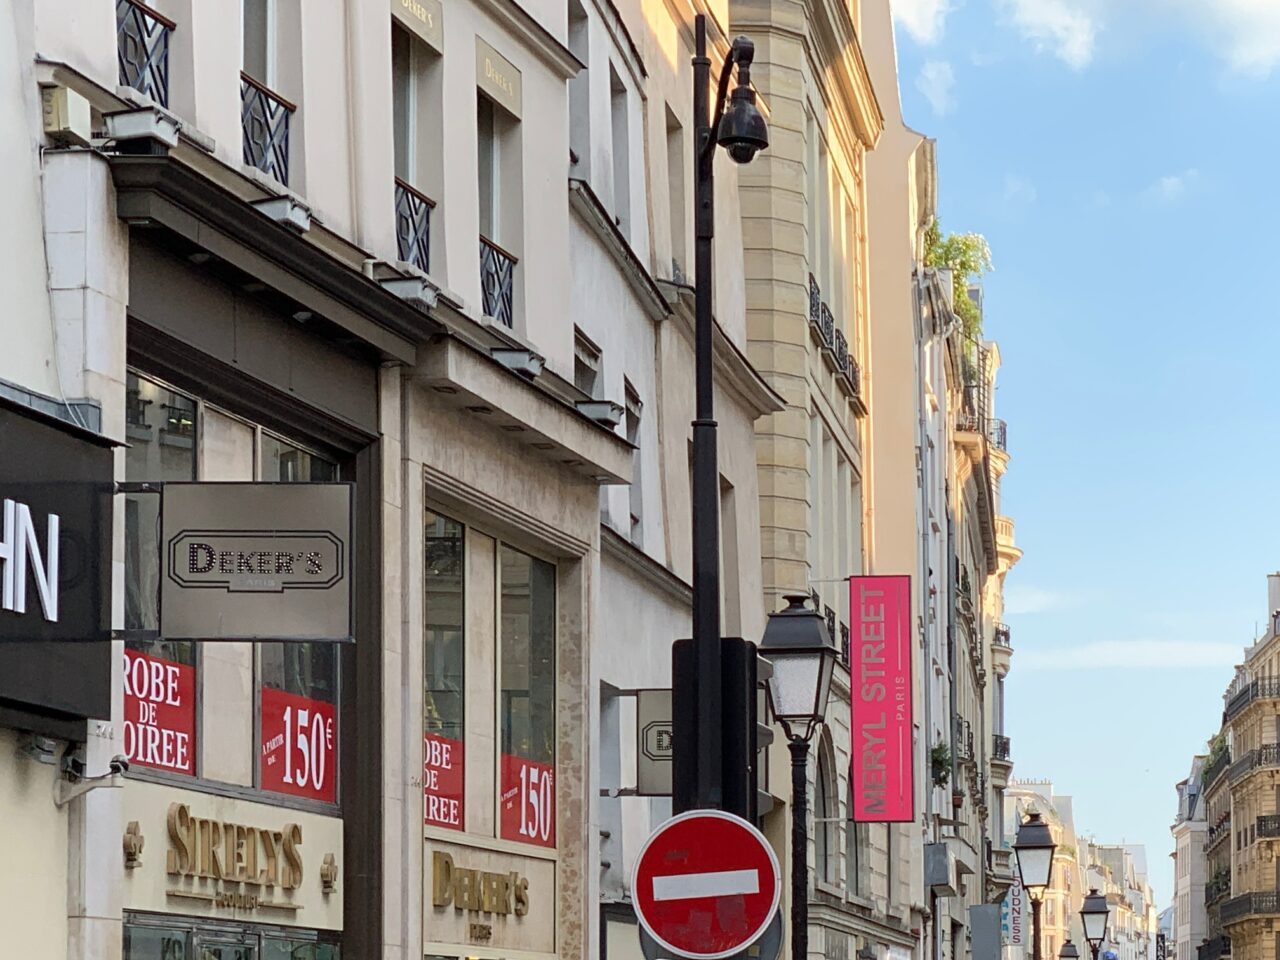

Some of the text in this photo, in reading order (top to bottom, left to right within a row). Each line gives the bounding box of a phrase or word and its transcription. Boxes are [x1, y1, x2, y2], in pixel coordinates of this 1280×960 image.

[188, 543, 324, 575] DEKER'S
[139, 700, 158, 726] DE
[860, 584, 887, 815] MERYL STREET
[895, 675, 905, 721] PARIS
[282, 705, 333, 791] 150€
